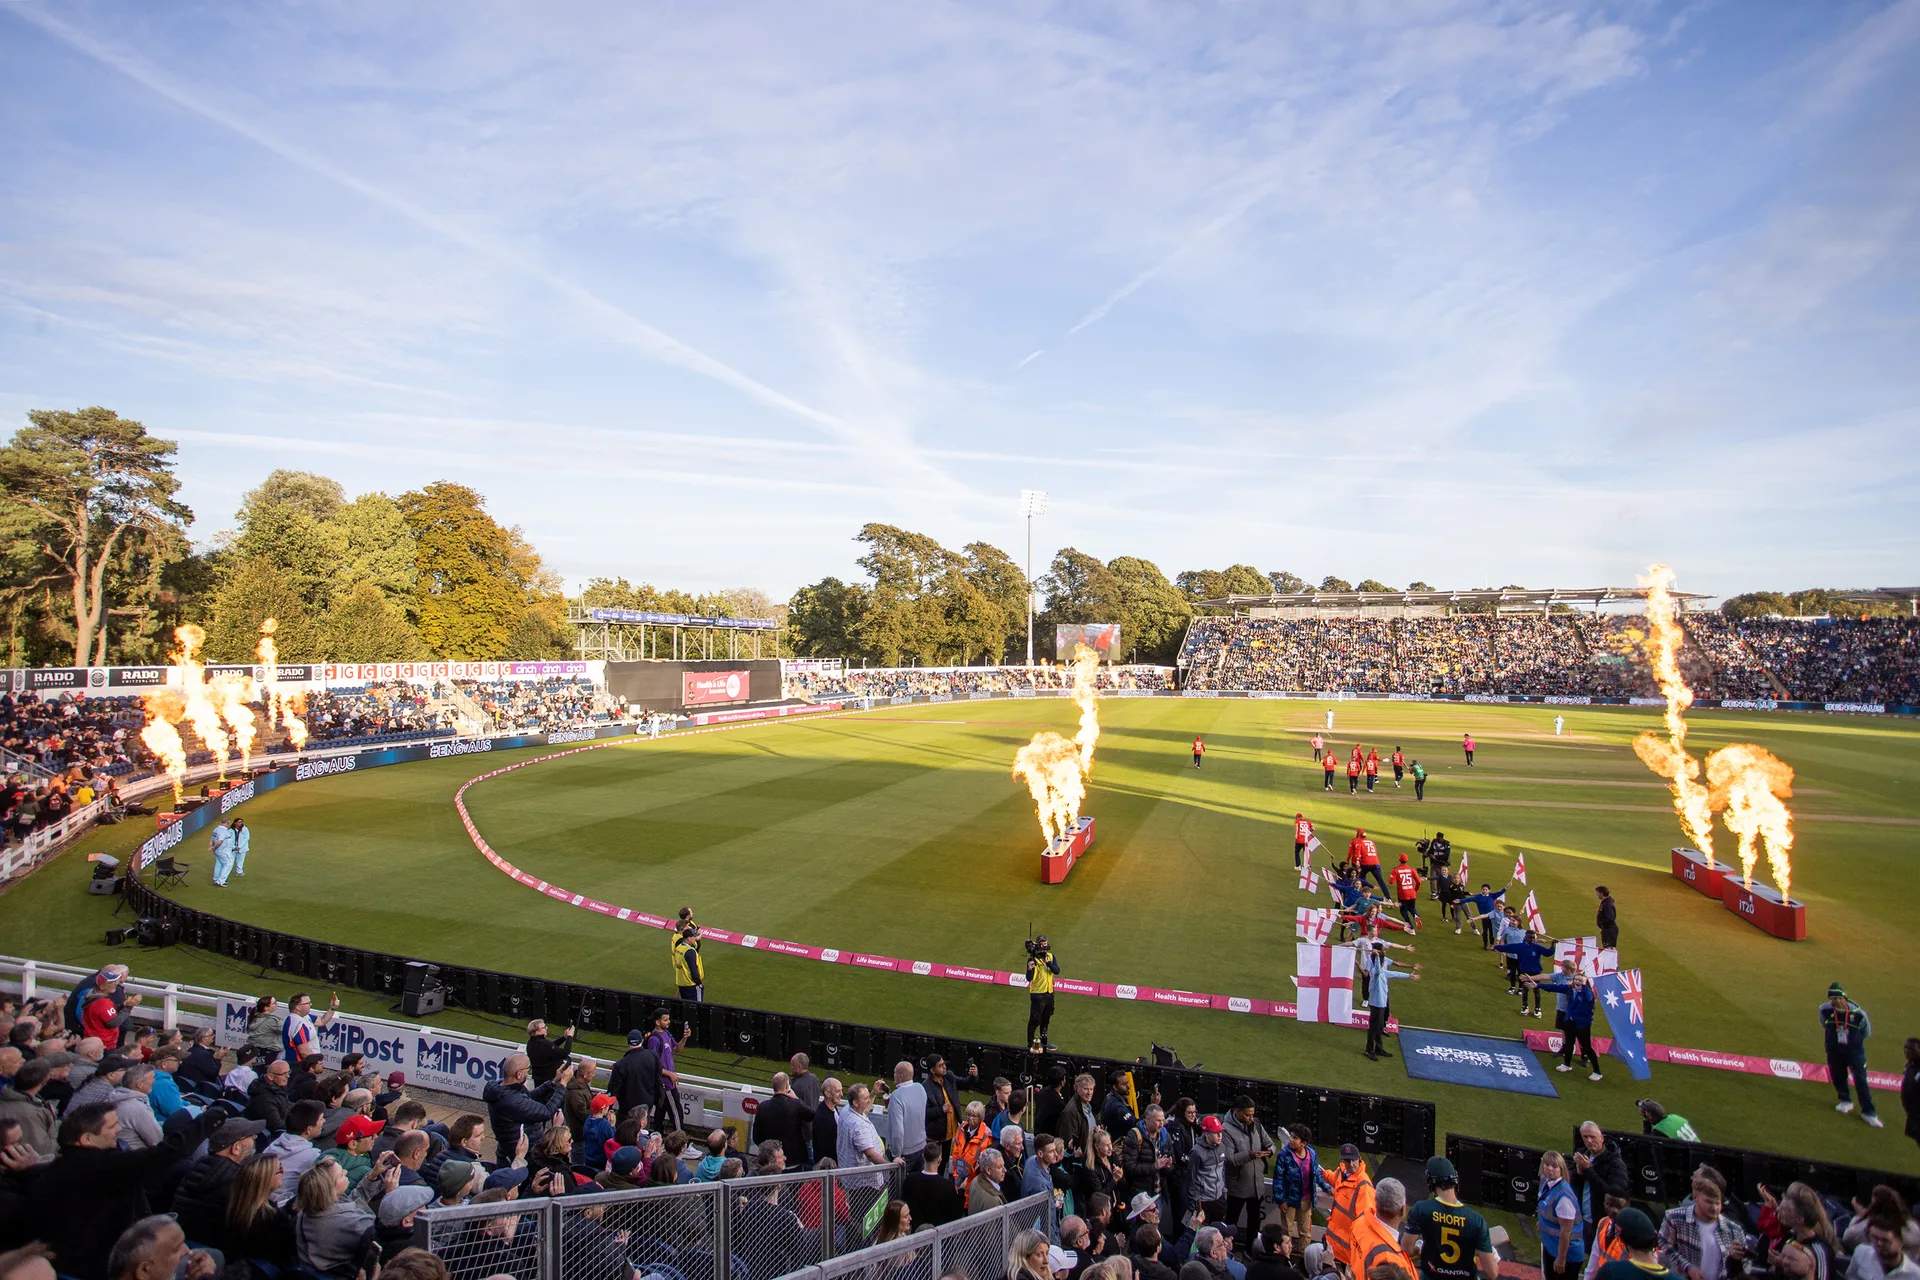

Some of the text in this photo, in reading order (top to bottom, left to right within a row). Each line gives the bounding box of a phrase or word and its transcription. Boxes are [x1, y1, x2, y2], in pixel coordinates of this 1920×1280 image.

[34, 672, 74, 682] RADO
[122, 671, 159, 679] RADO
[278, 668, 304, 676] RADO
[1824, 703, 1885, 713] #ENGvAUS
[548, 730, 595, 744] #ENGvAUS
[430, 739, 491, 758] #ENGvAUS
[296, 756, 355, 781] #ENGvAUS
[221, 781, 254, 814] #ENGvAUS
[141, 820, 183, 869] #ENGvAUS
[1365, 843, 1376, 853] 75
[1400, 873, 1413, 885] 25
[769, 942, 785, 950] Health
[946, 968, 965, 977] Health
[1117, 985, 1136, 996] Vitality
[1155, 992, 1176, 1001] Health
[1230, 998, 1249, 1009] Vitality
[1275, 1005, 1288, 1013] Life
[318, 1022, 404, 1064] MiPost
[1415, 1048, 1492, 1063] ENGLAND
[1423, 1045, 1490, 1058] CRICKET
[1668, 1050, 1699, 1062] Health
[1771, 1061, 1801, 1076] Vitality
[416, 1070, 476, 1091] Post made simple
[680, 1093, 698, 1102] LOCK
[683, 1103, 691, 1115] 5
[744, 1102, 758, 1110] NEW
[1432, 1211, 1466, 1227] SHORT
[1439, 1226, 1461, 1264] 5
[1436, 1267, 1470, 1276] QANTAS
